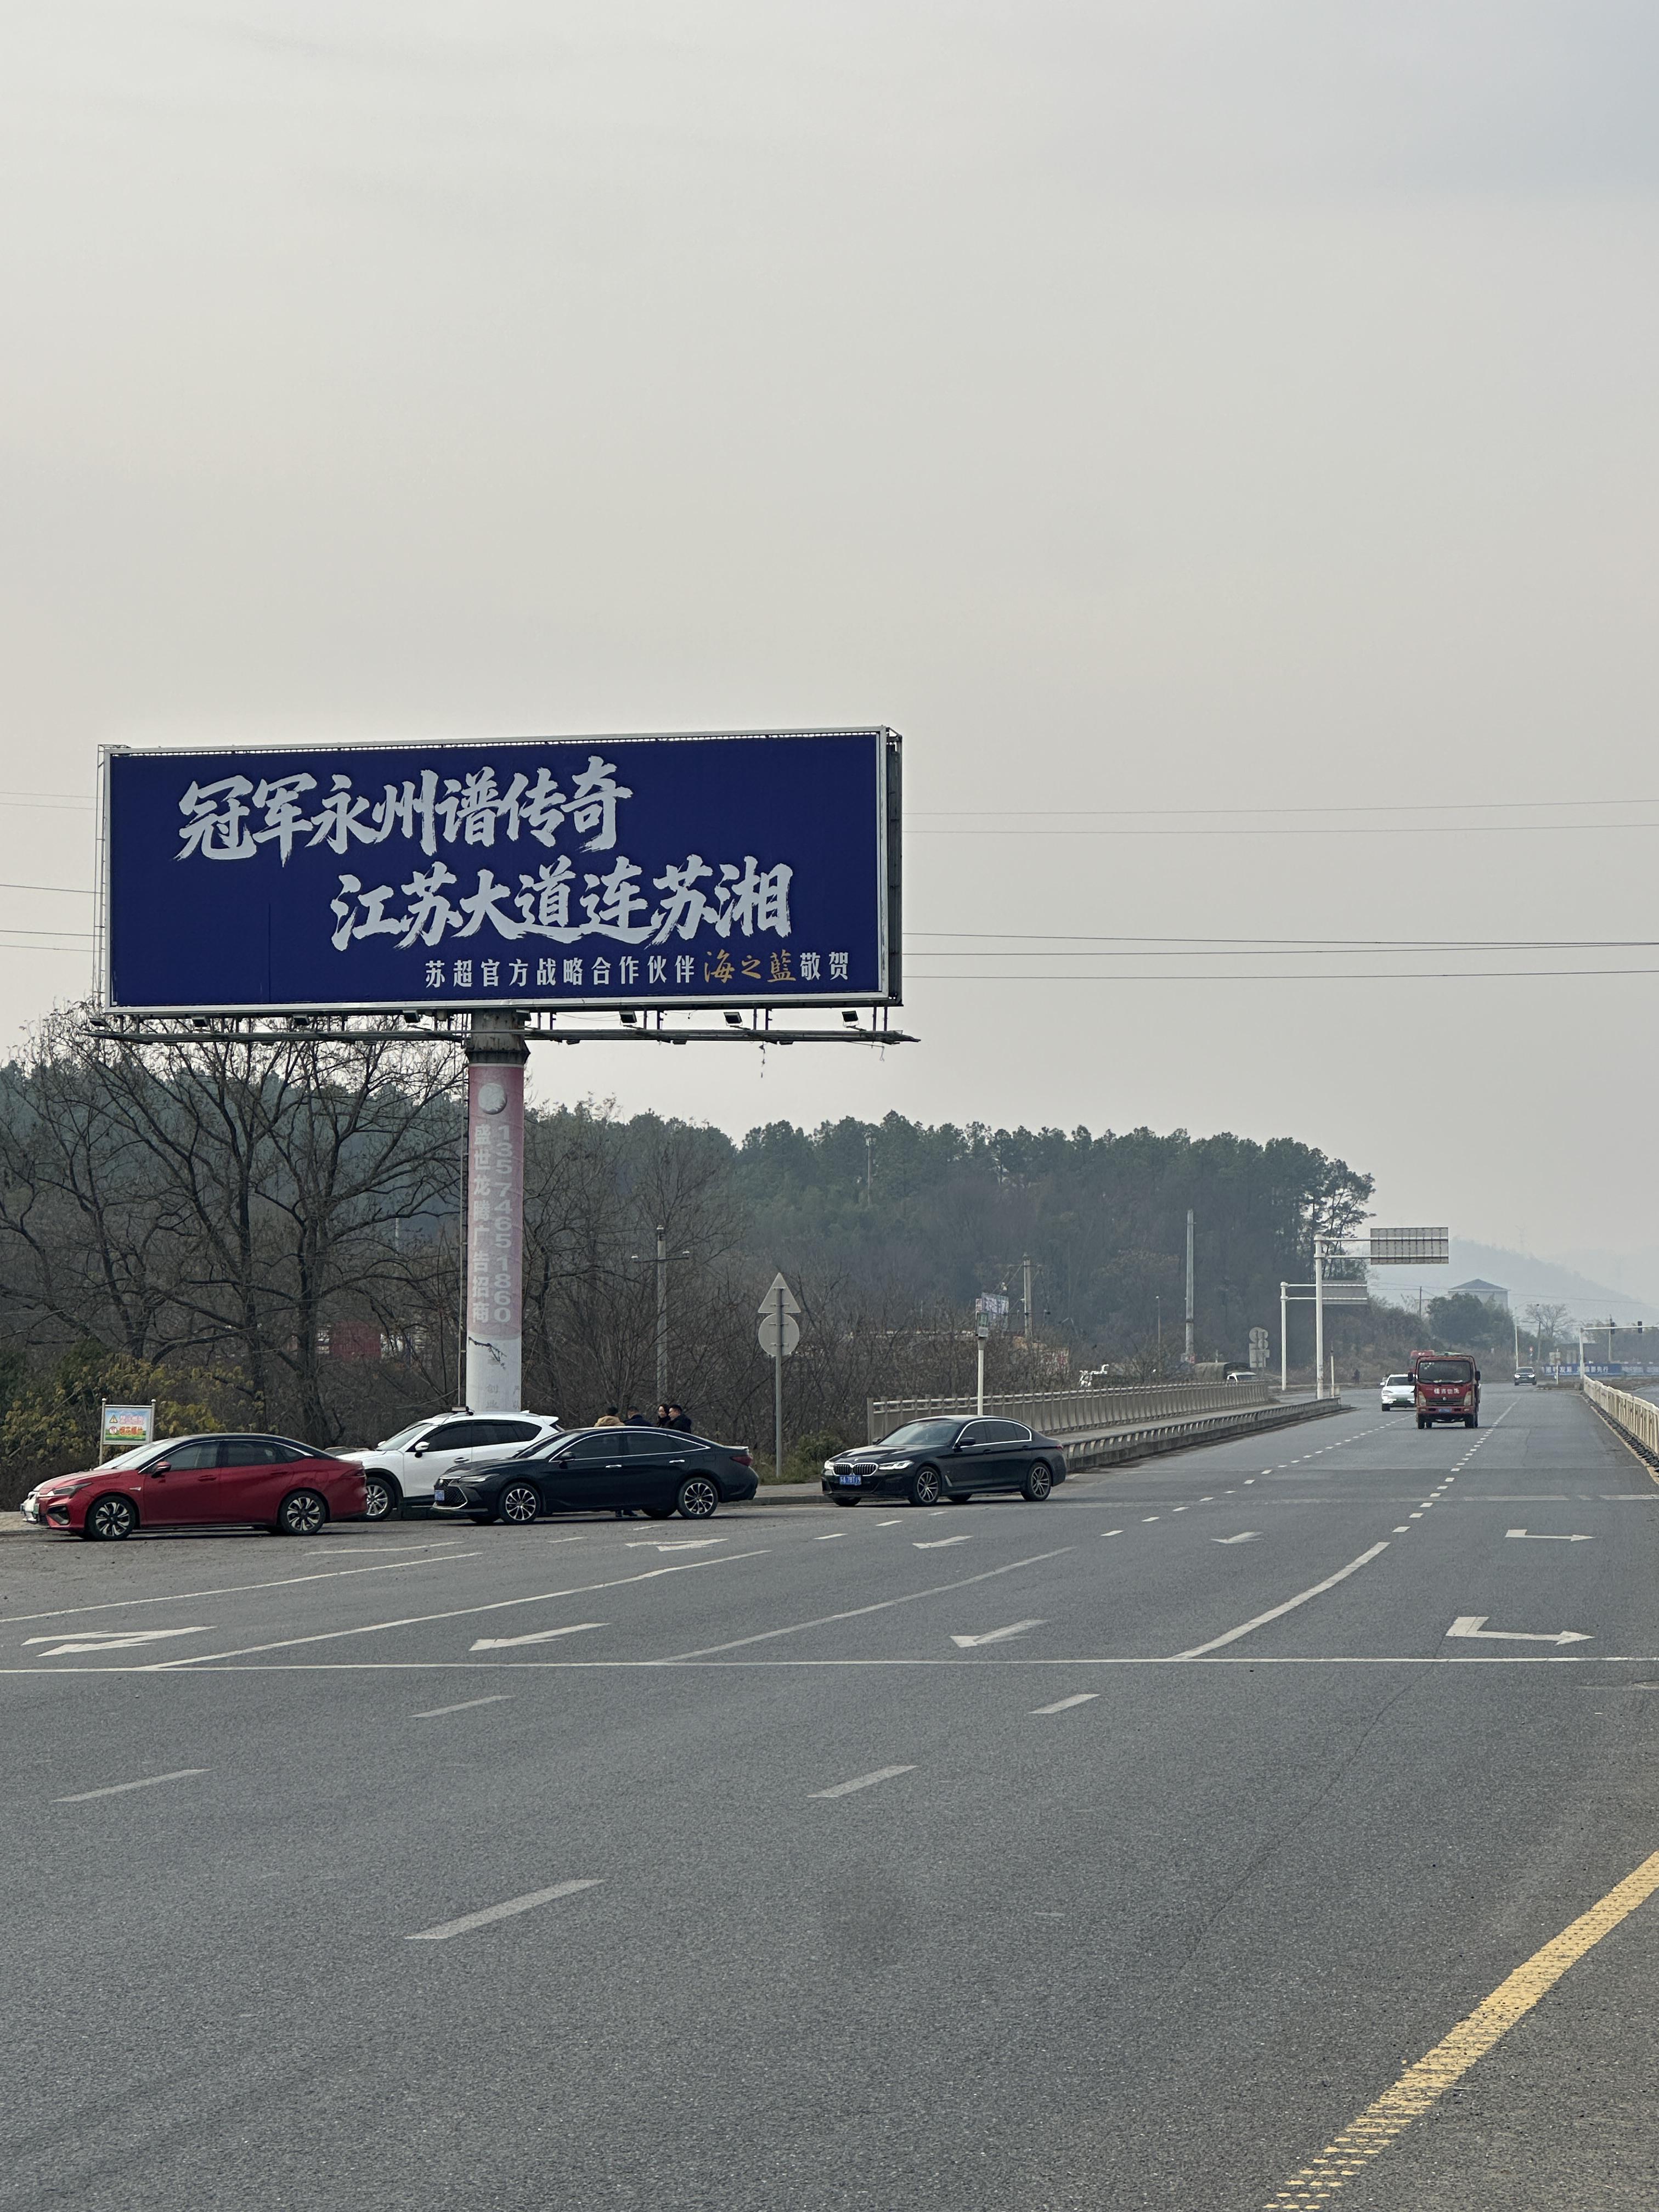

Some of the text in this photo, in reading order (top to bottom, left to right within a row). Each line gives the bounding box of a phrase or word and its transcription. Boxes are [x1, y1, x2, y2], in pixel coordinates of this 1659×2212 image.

[170, 755, 634, 868] 冠军永州谱传奇
[330, 854, 793, 952] 江苏大道连苏湘
[472, 1124, 491, 1323] 盛世龙腾广告招商
[494, 1125, 513, 1323] 13574651860
